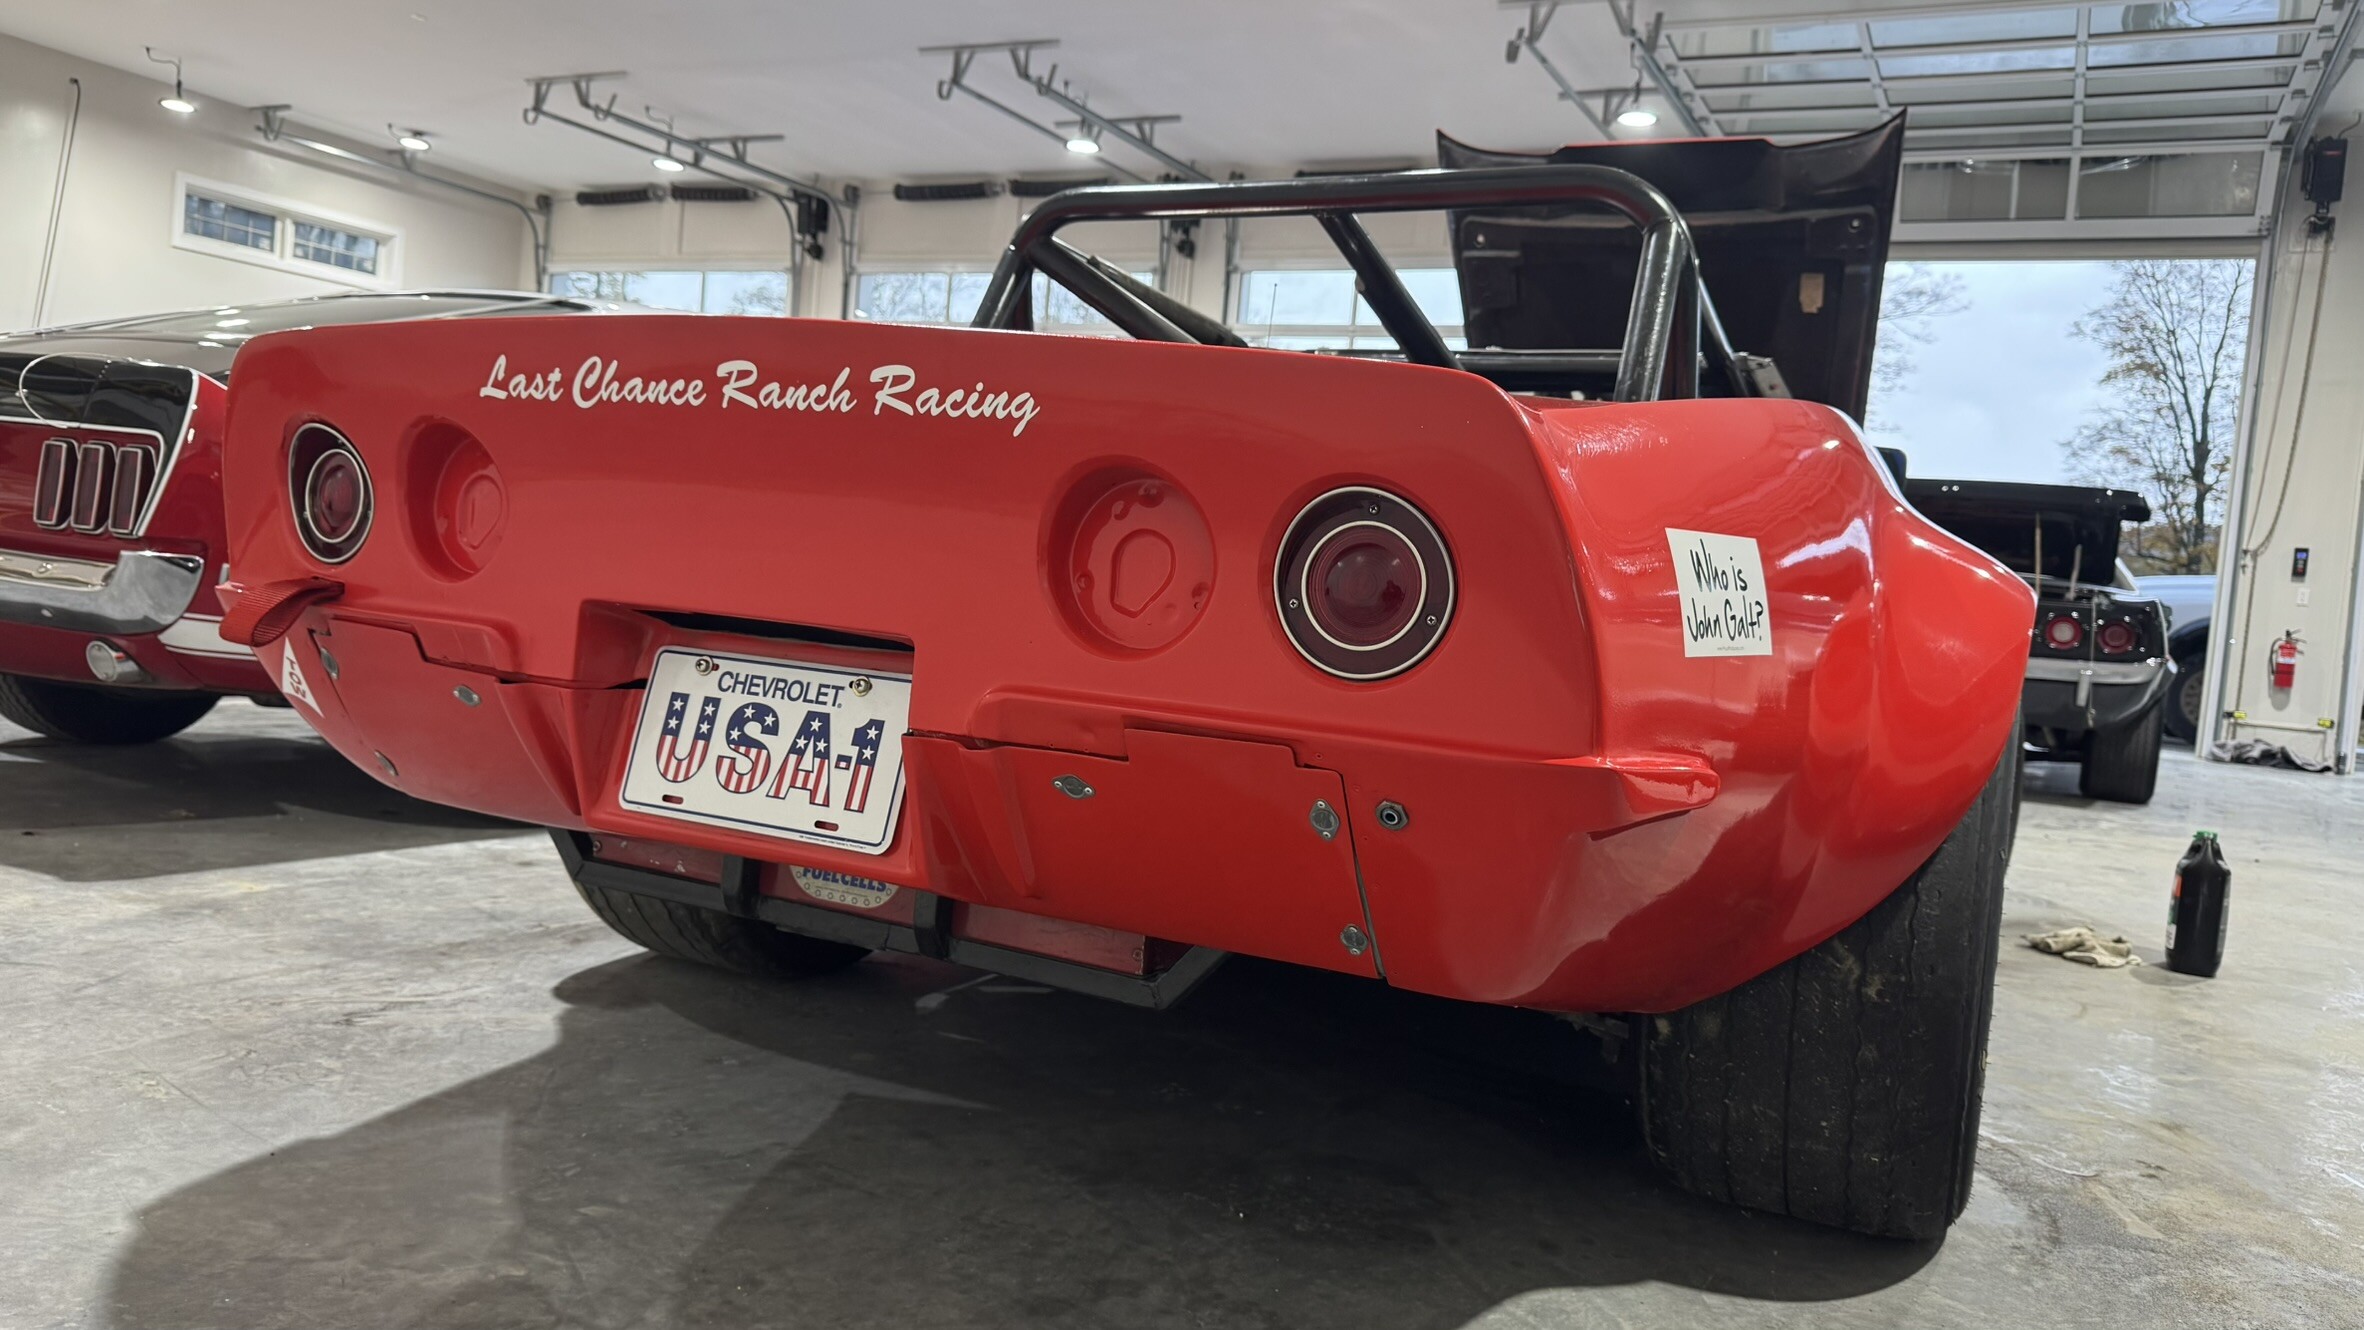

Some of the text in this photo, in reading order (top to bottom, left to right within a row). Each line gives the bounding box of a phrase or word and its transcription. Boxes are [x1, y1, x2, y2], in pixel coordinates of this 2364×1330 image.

[479, 354, 1041, 437] Last Chance Ranch Racing
[1689, 538, 1748, 593] Who is
[1687, 595, 1764, 643] John Galt?
[717, 670, 845, 708] CHEVROLET
[656, 691, 885, 814] USA-1
